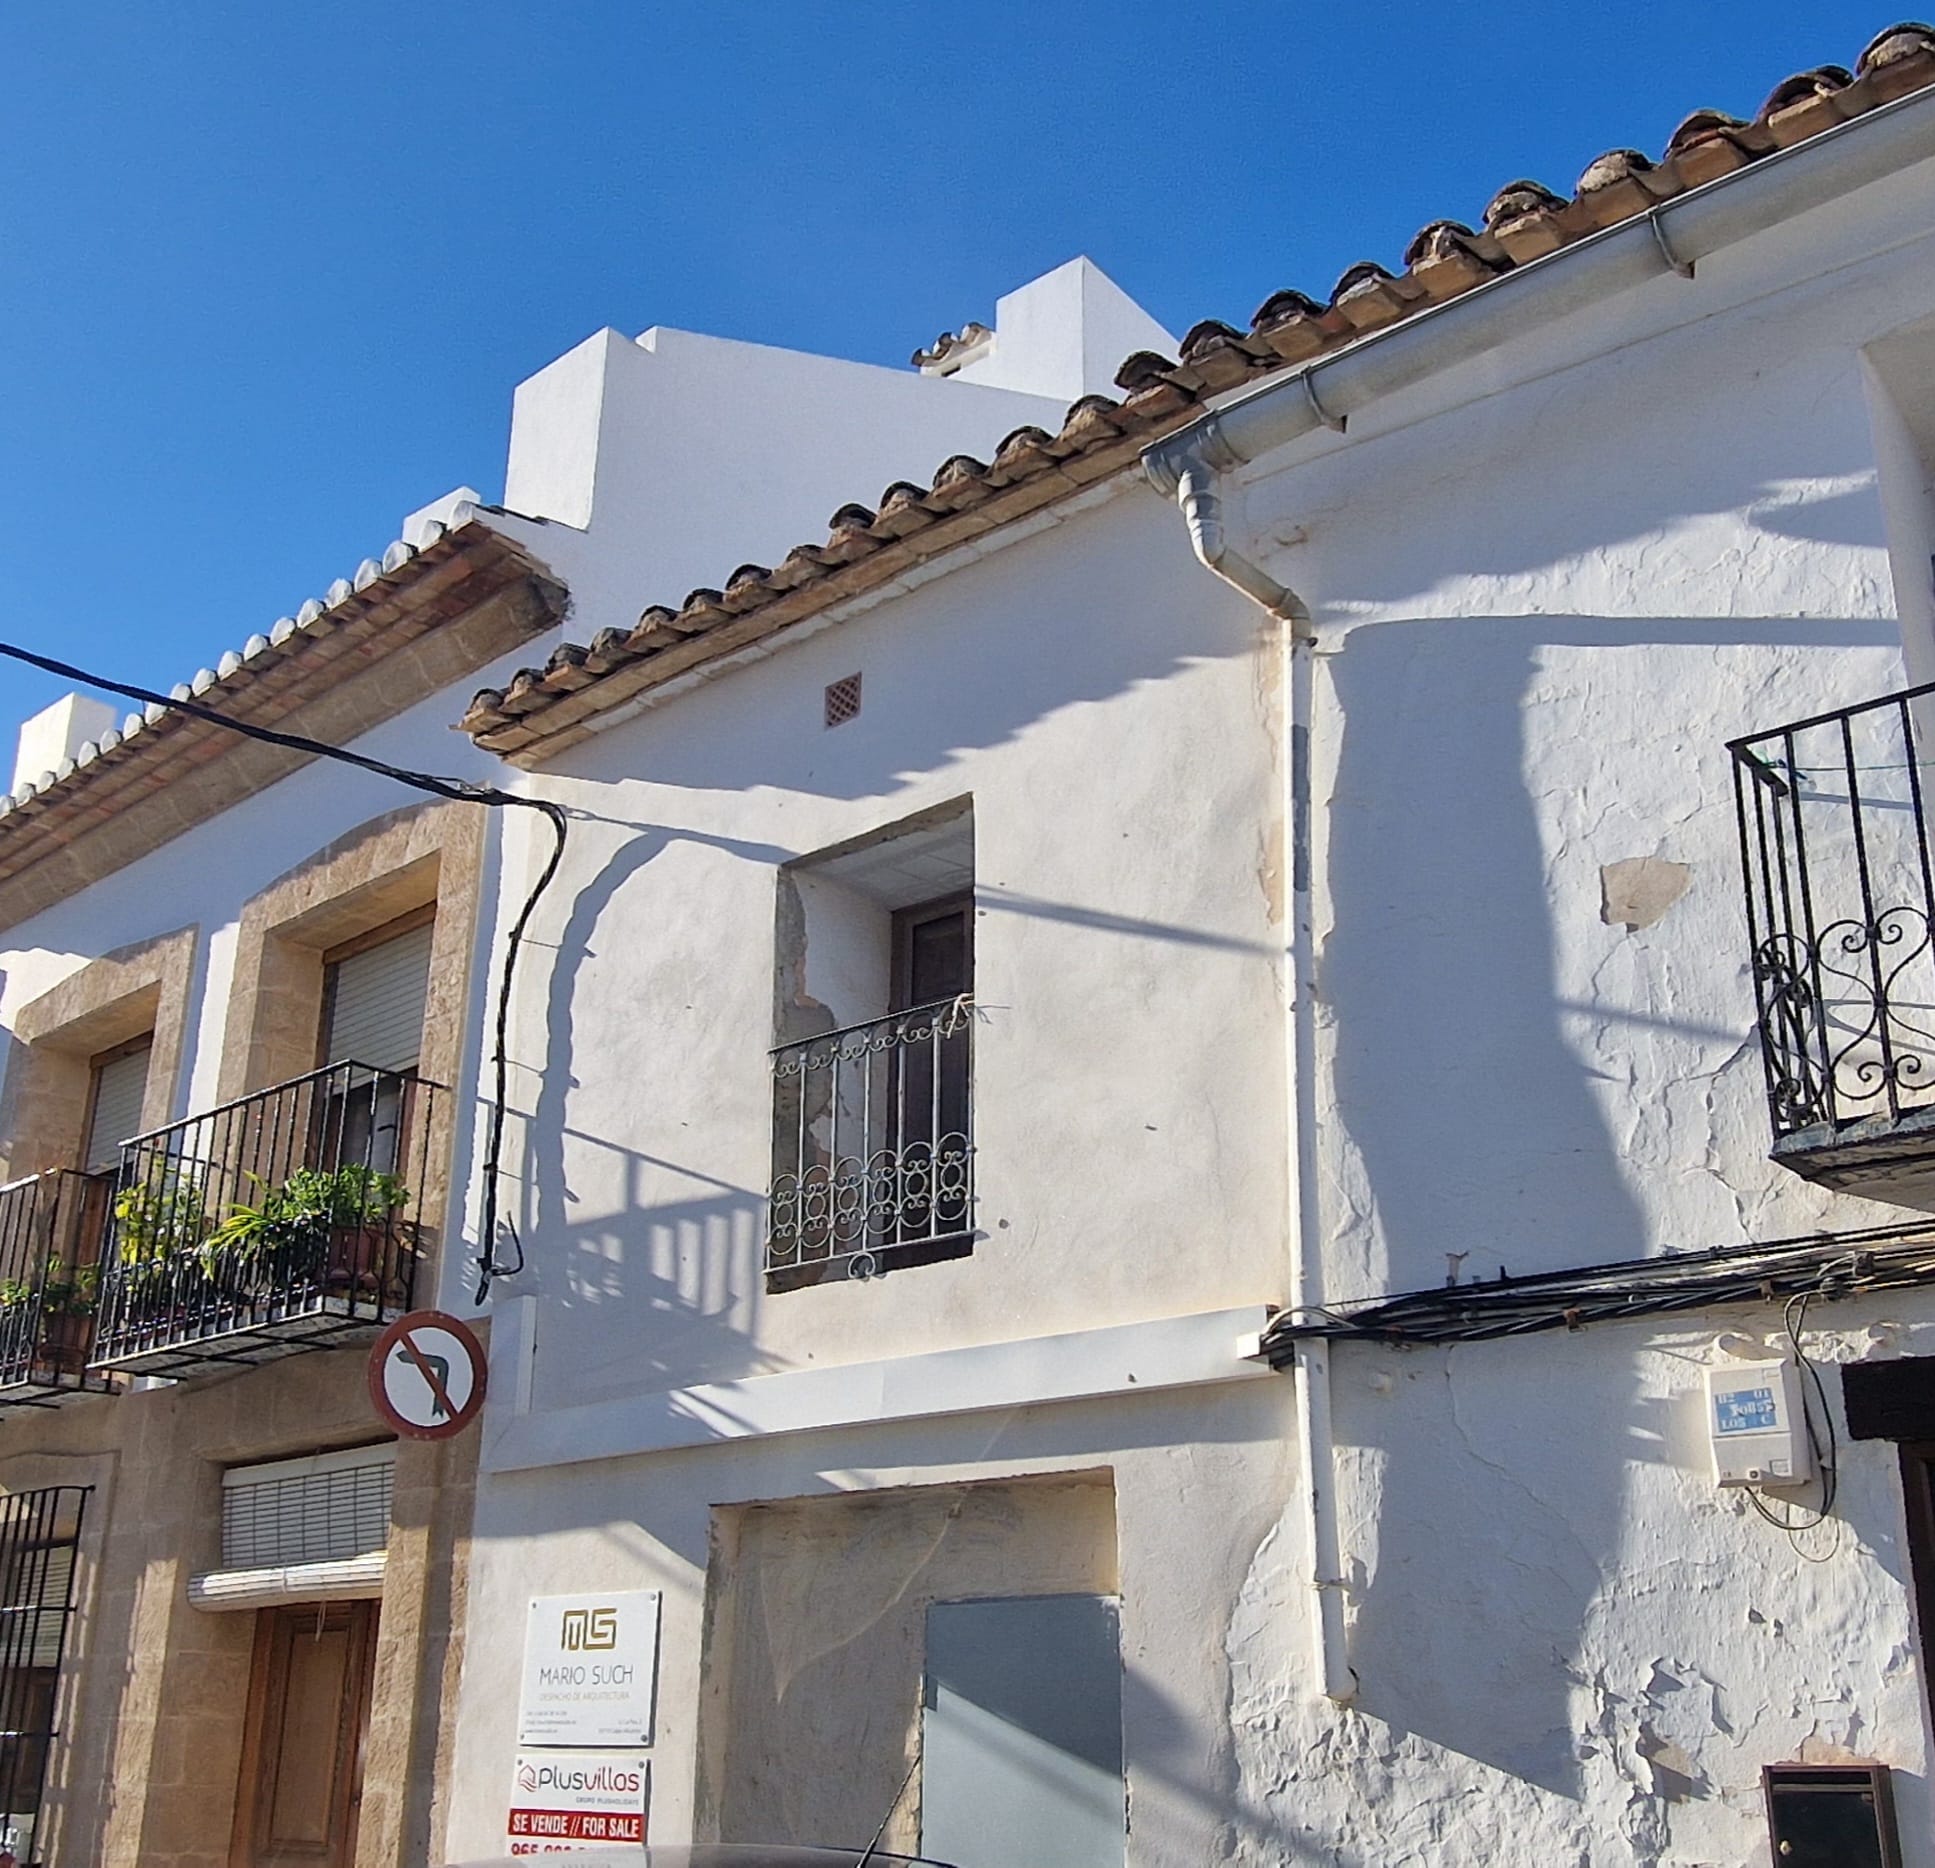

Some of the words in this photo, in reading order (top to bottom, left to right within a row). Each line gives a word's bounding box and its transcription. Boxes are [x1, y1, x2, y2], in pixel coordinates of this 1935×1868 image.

[540, 1666, 586, 1685] MARIO
[592, 1664, 633, 1685] SUCH
[513, 1813, 528, 1832] SE
[531, 1814, 568, 1835] VENDE
[582, 1817, 606, 1836] FOR
[609, 1818, 639, 1838] SALE
